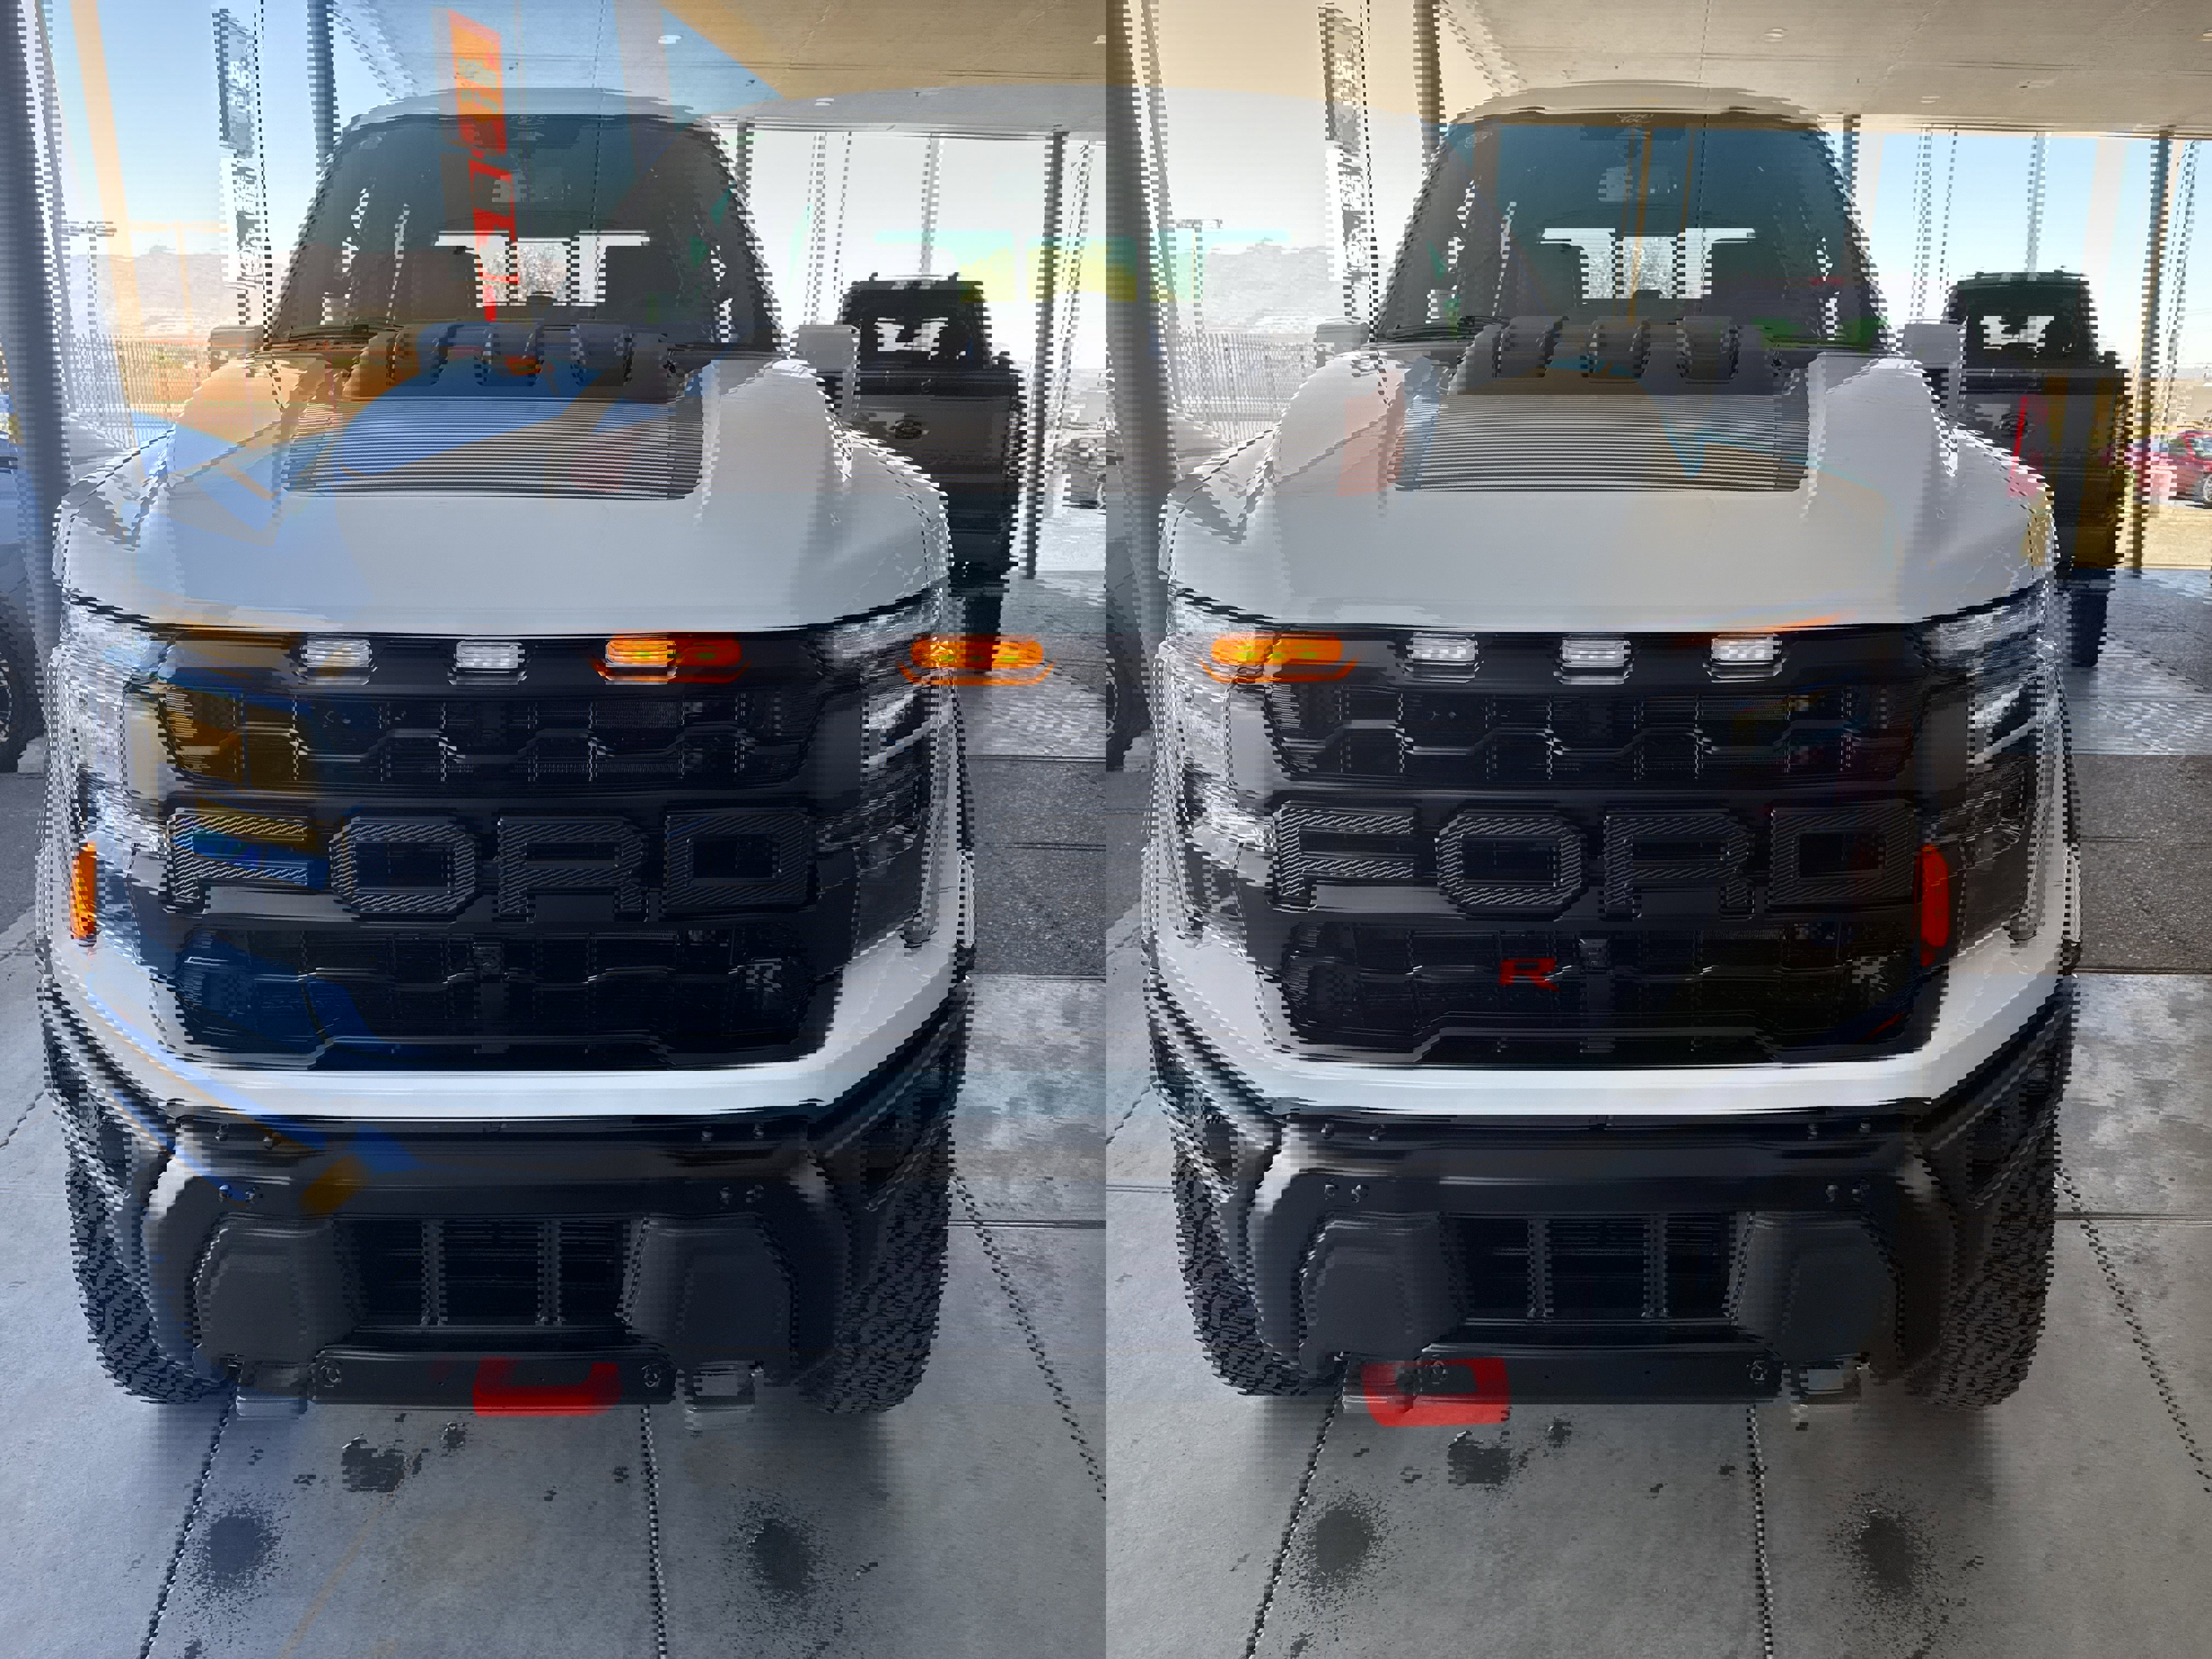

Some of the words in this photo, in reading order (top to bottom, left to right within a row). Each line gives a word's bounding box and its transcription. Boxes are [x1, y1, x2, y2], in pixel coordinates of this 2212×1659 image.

[458, 57, 498, 92] native
[472, 188, 489, 211] CAR
[482, 174, 512, 199] EXPRESS
[338, 803, 1625, 916] FORD
[1498, 957, 1561, 992] R
